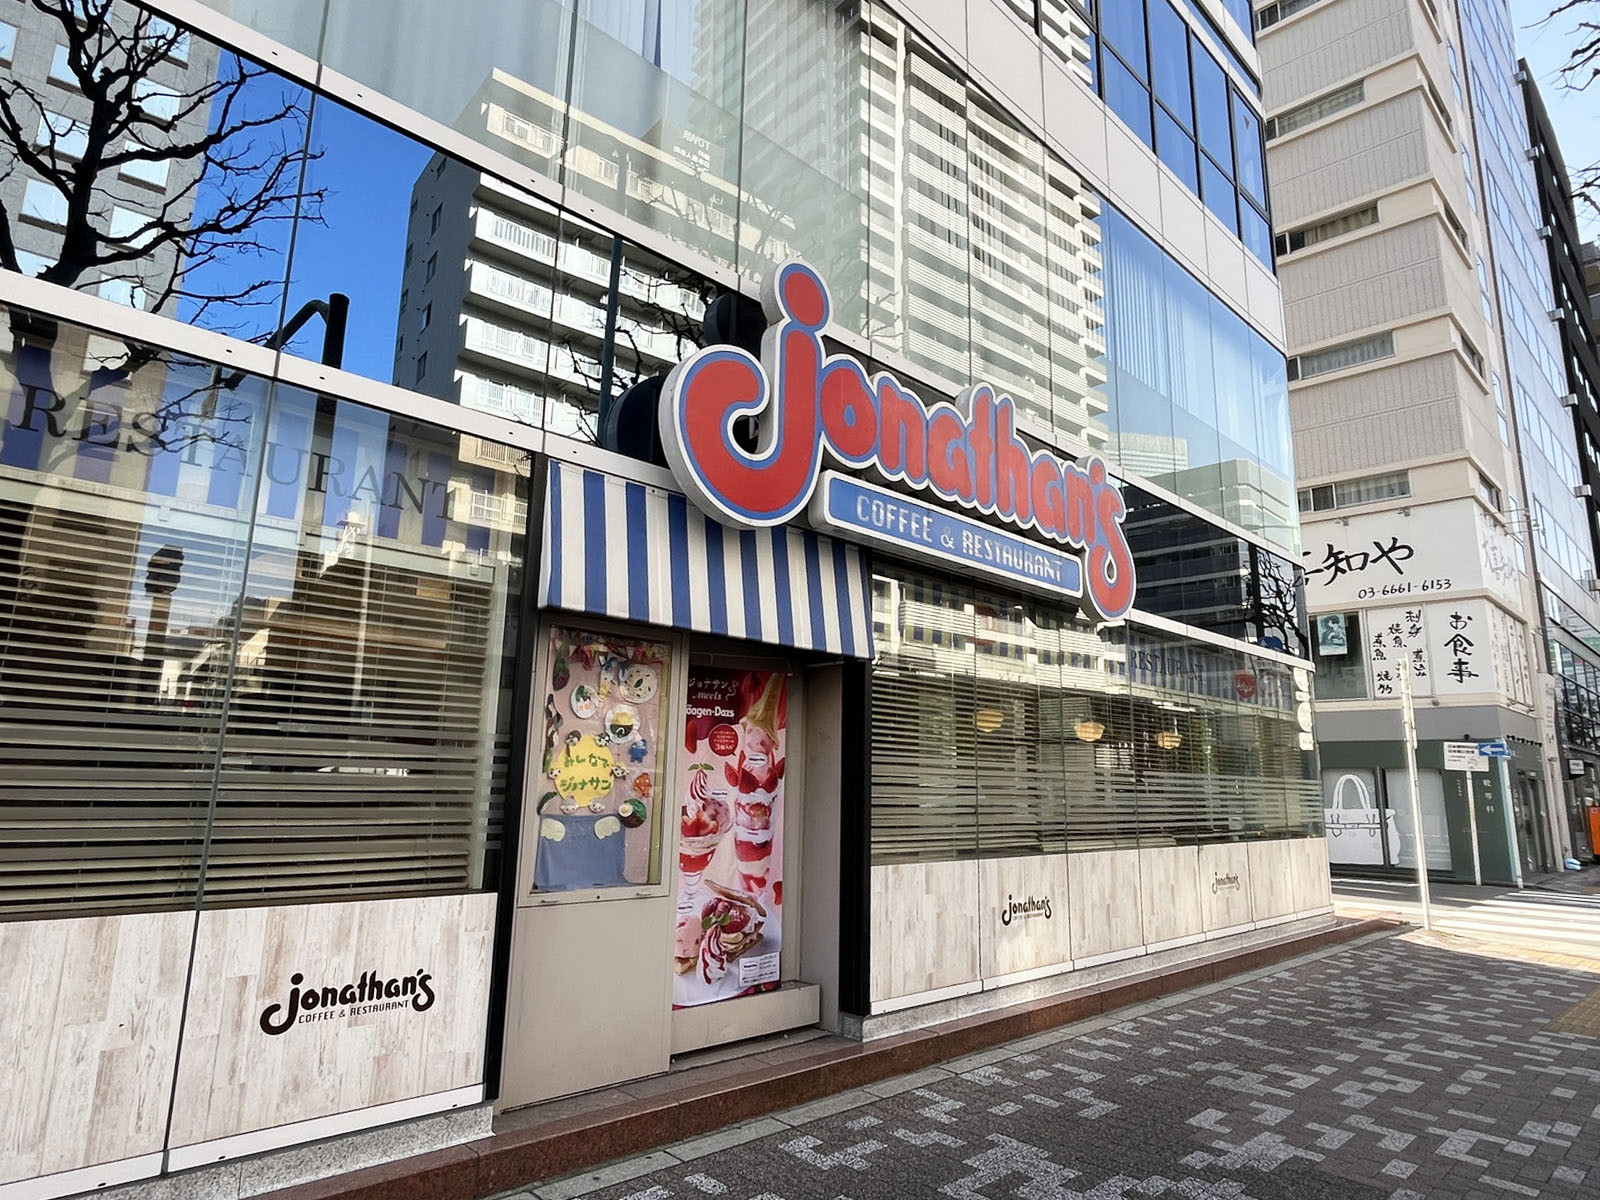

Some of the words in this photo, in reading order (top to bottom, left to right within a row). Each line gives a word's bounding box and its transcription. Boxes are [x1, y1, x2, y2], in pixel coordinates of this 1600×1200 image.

[14, 384, 459, 520] RESTAURANT
[856, 493, 933, 543] COFFEE
[940, 526, 955, 549] &
[962, 528, 1063, 583] RESTAURANT
[1303, 537, 1414, 586] 知や
[1358, 578, 1452, 599] 03-6661-6153
[1388, 623, 1408, 648] 焼魚
[1405, 609, 1423, 638] 刺身
[1373, 632, 1387, 661] 煮魚
[1444, 611, 1479, 684] お食事
[1130, 650, 1204, 683] RESTAURANT
[560, 776, 612, 792] ジョナサン
[1002, 894, 1052, 926] jonathan's
[259, 968, 436, 1036] jonathan's
[298, 1011, 335, 1024] COFFEE
[338, 1010, 346, 1018] &
[350, 1000, 410, 1017] RESTAURANT
